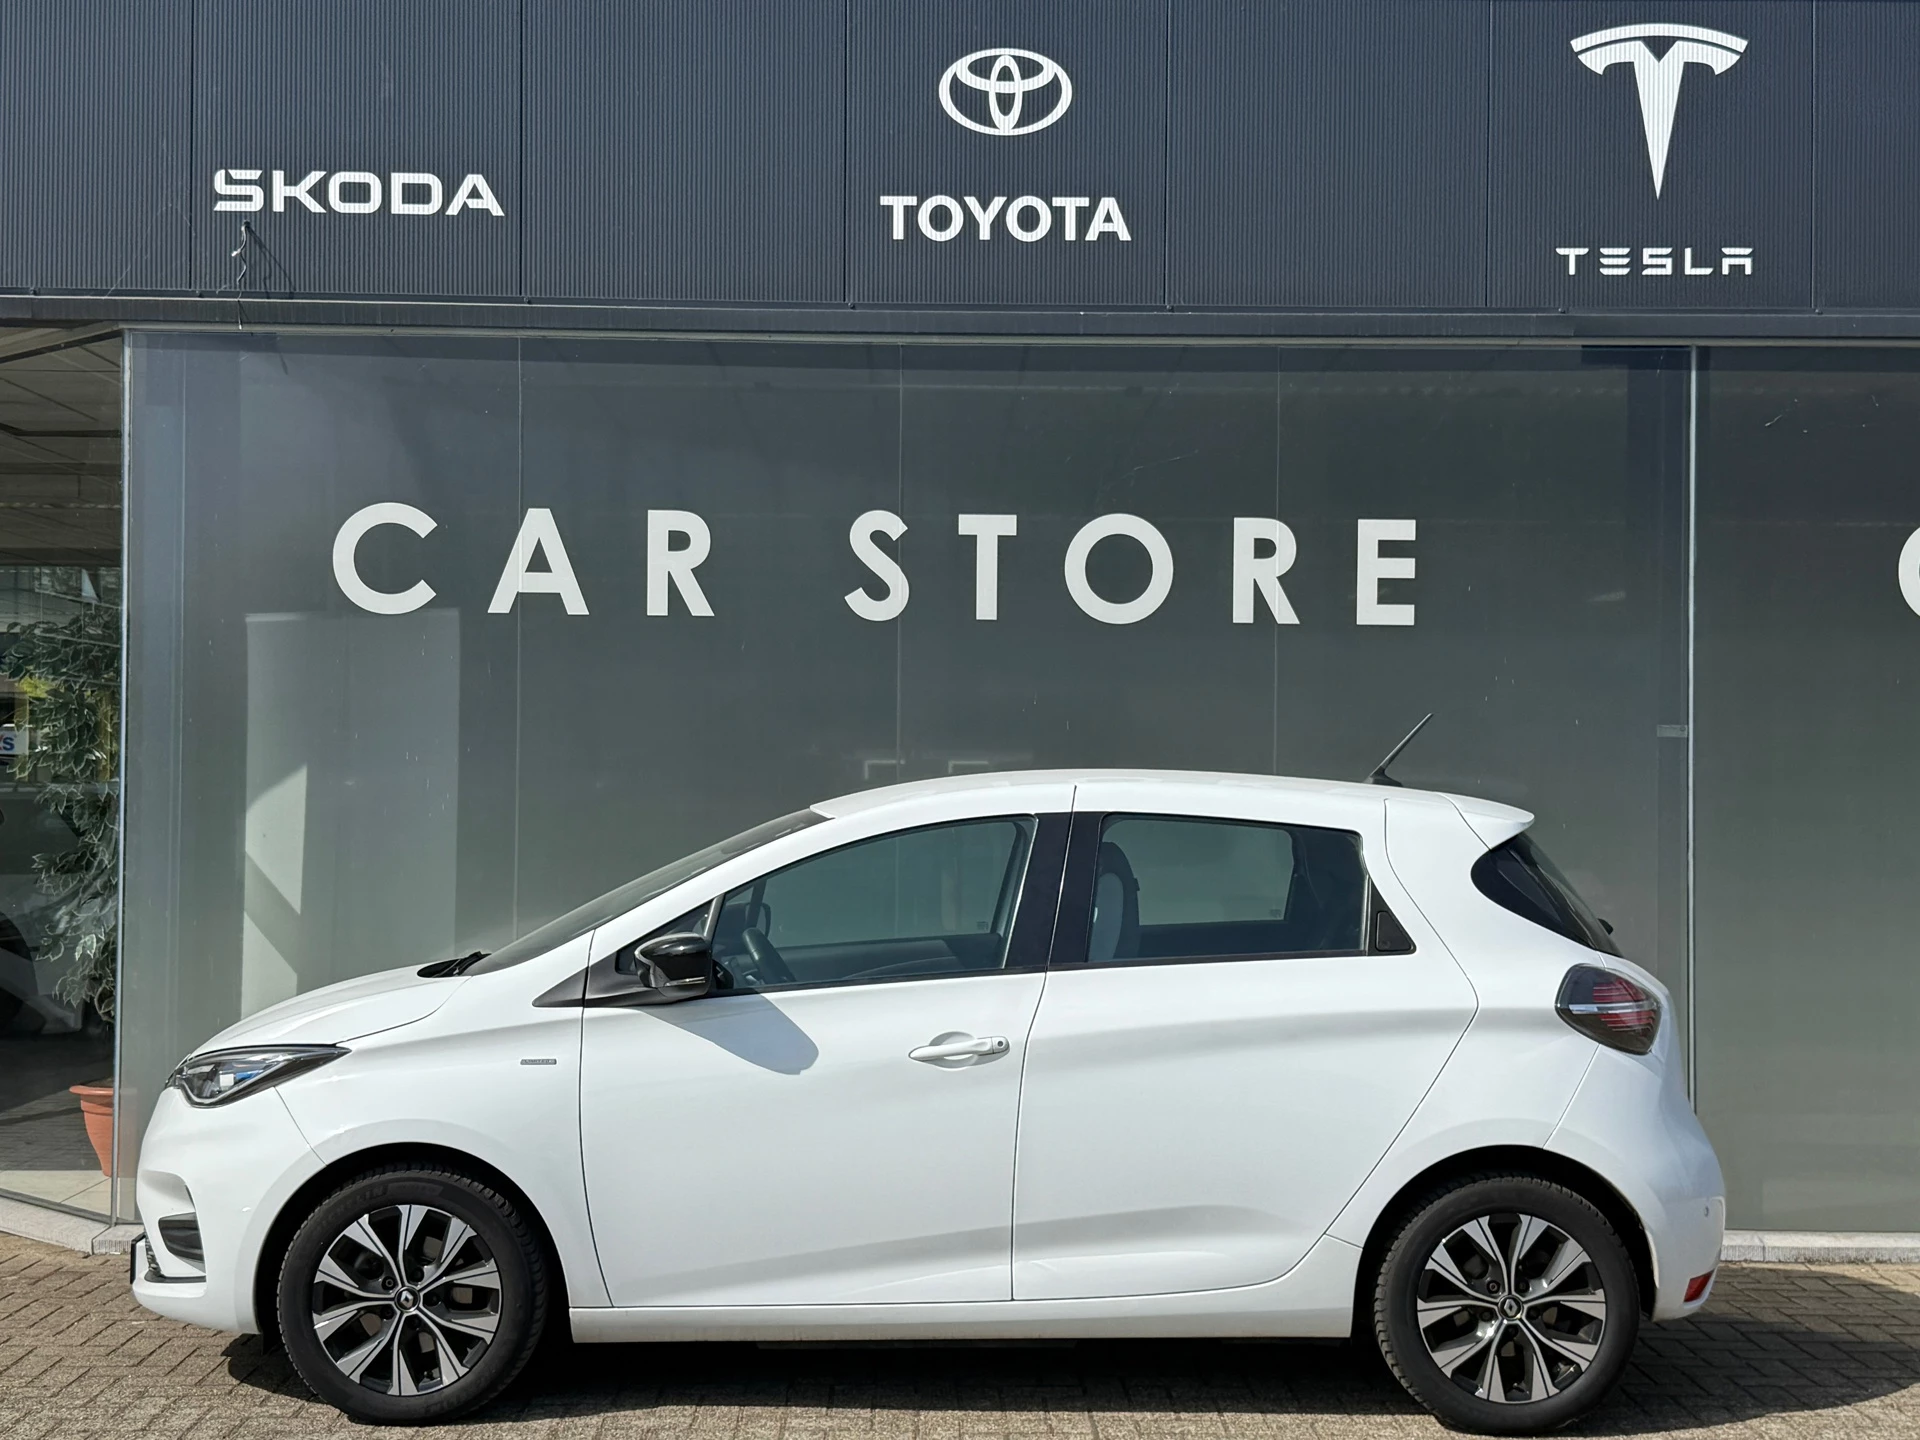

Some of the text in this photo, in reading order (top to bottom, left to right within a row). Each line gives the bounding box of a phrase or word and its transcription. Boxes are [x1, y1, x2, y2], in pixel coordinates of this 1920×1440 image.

[880, 195, 1131, 242] TOYOTA
[1556, 248, 1752, 276] TESLA
[333, 503, 1416, 625] CAR STORE
